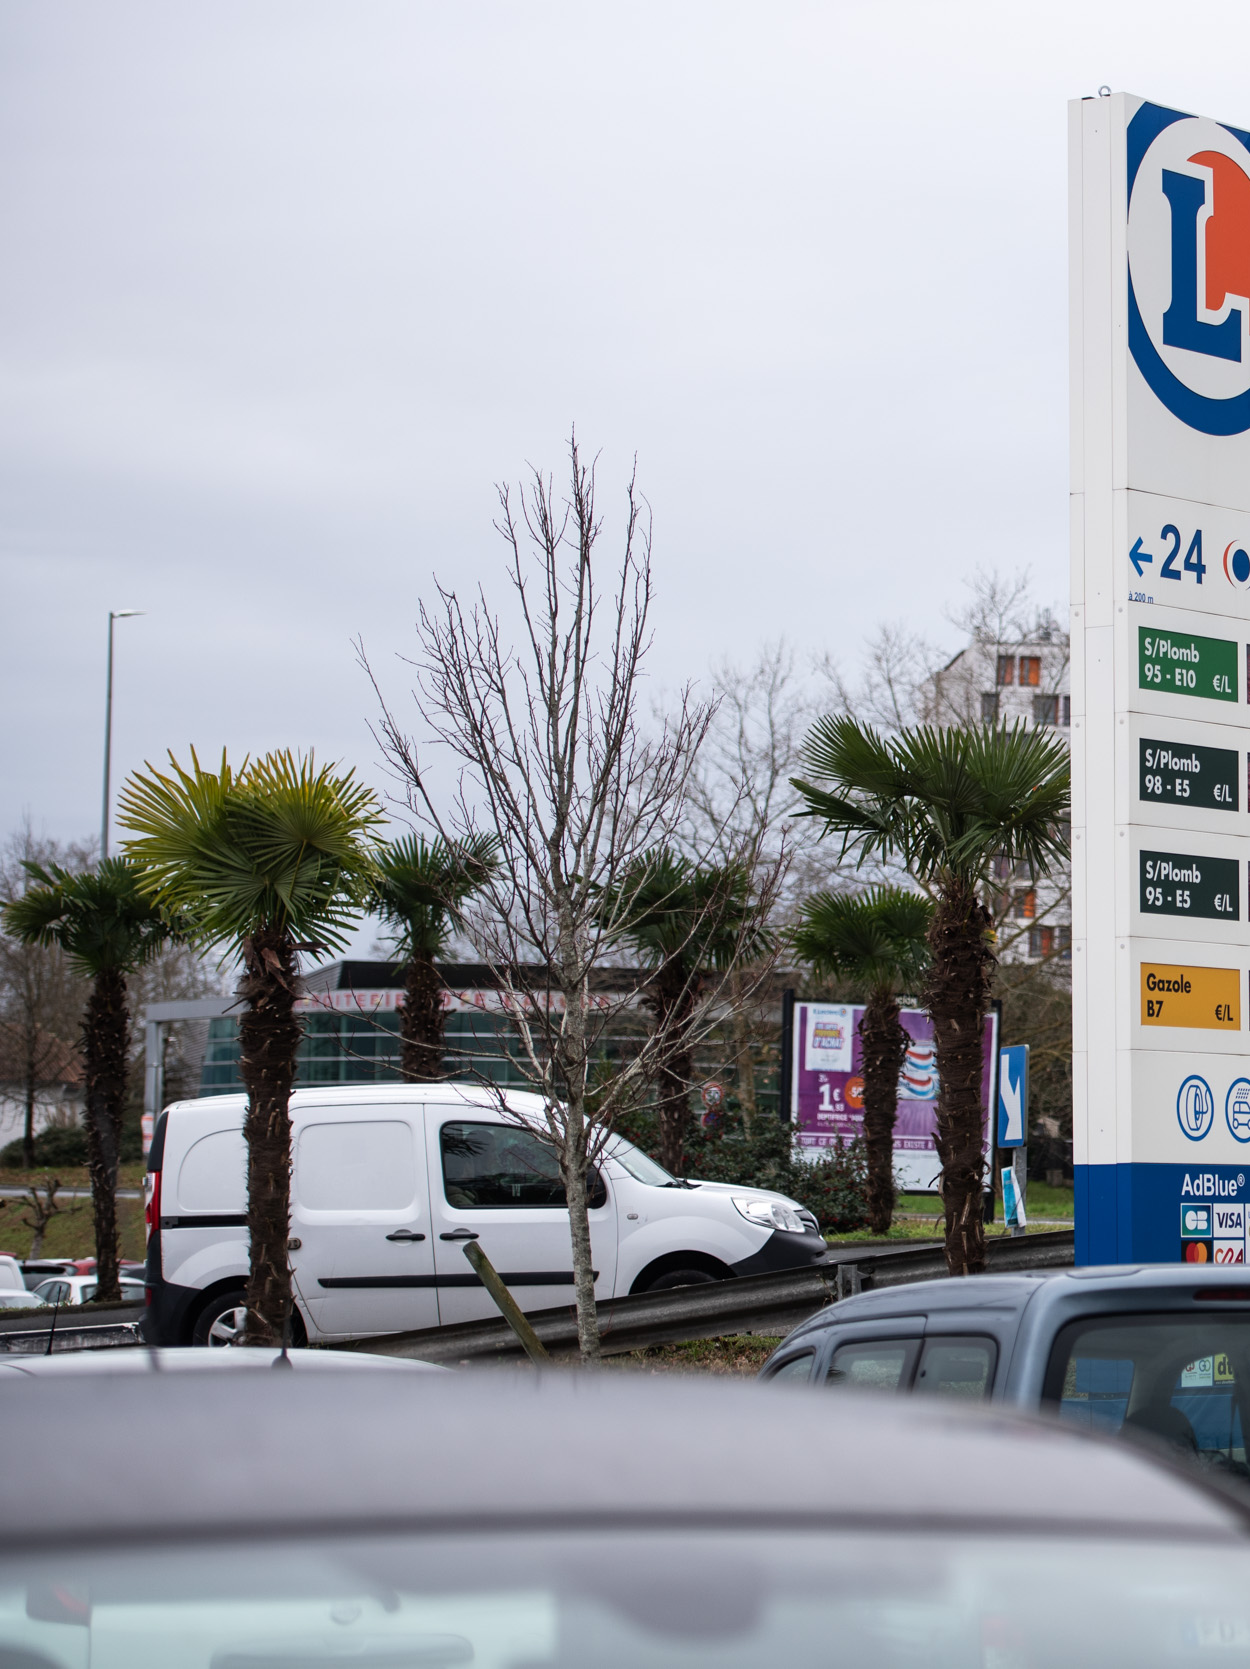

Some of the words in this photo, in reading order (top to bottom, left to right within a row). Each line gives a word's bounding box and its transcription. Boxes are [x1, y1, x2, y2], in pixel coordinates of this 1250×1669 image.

[1162, 168, 1242, 363] L
[1160, 524, 1206, 584] 24
[1134, 592, 1146, 603] 200
[1147, 596, 1154, 604] m
[1144, 638, 1200, 663] S/Plomb
[1144, 664, 1162, 684] 95
[1174, 669, 1196, 688] E10
[1212, 675, 1232, 693] €/L
[1145, 749, 1201, 773] S/Plomb
[1145, 775, 1162, 795] 98
[1175, 779, 1190, 798] E5
[1213, 785, 1232, 802] €/L
[1145, 861, 1201, 884] S/Plomb
[1145, 888, 1163, 906] 95
[1176, 890, 1191, 908] E5
[1214, 894, 1233, 912] €/L
[1146, 973, 1192, 994] Gazole
[1147, 1000, 1164, 1018] B7
[1215, 1004, 1234, 1022] €/L
[1216, 1212, 1242, 1229] VISA
